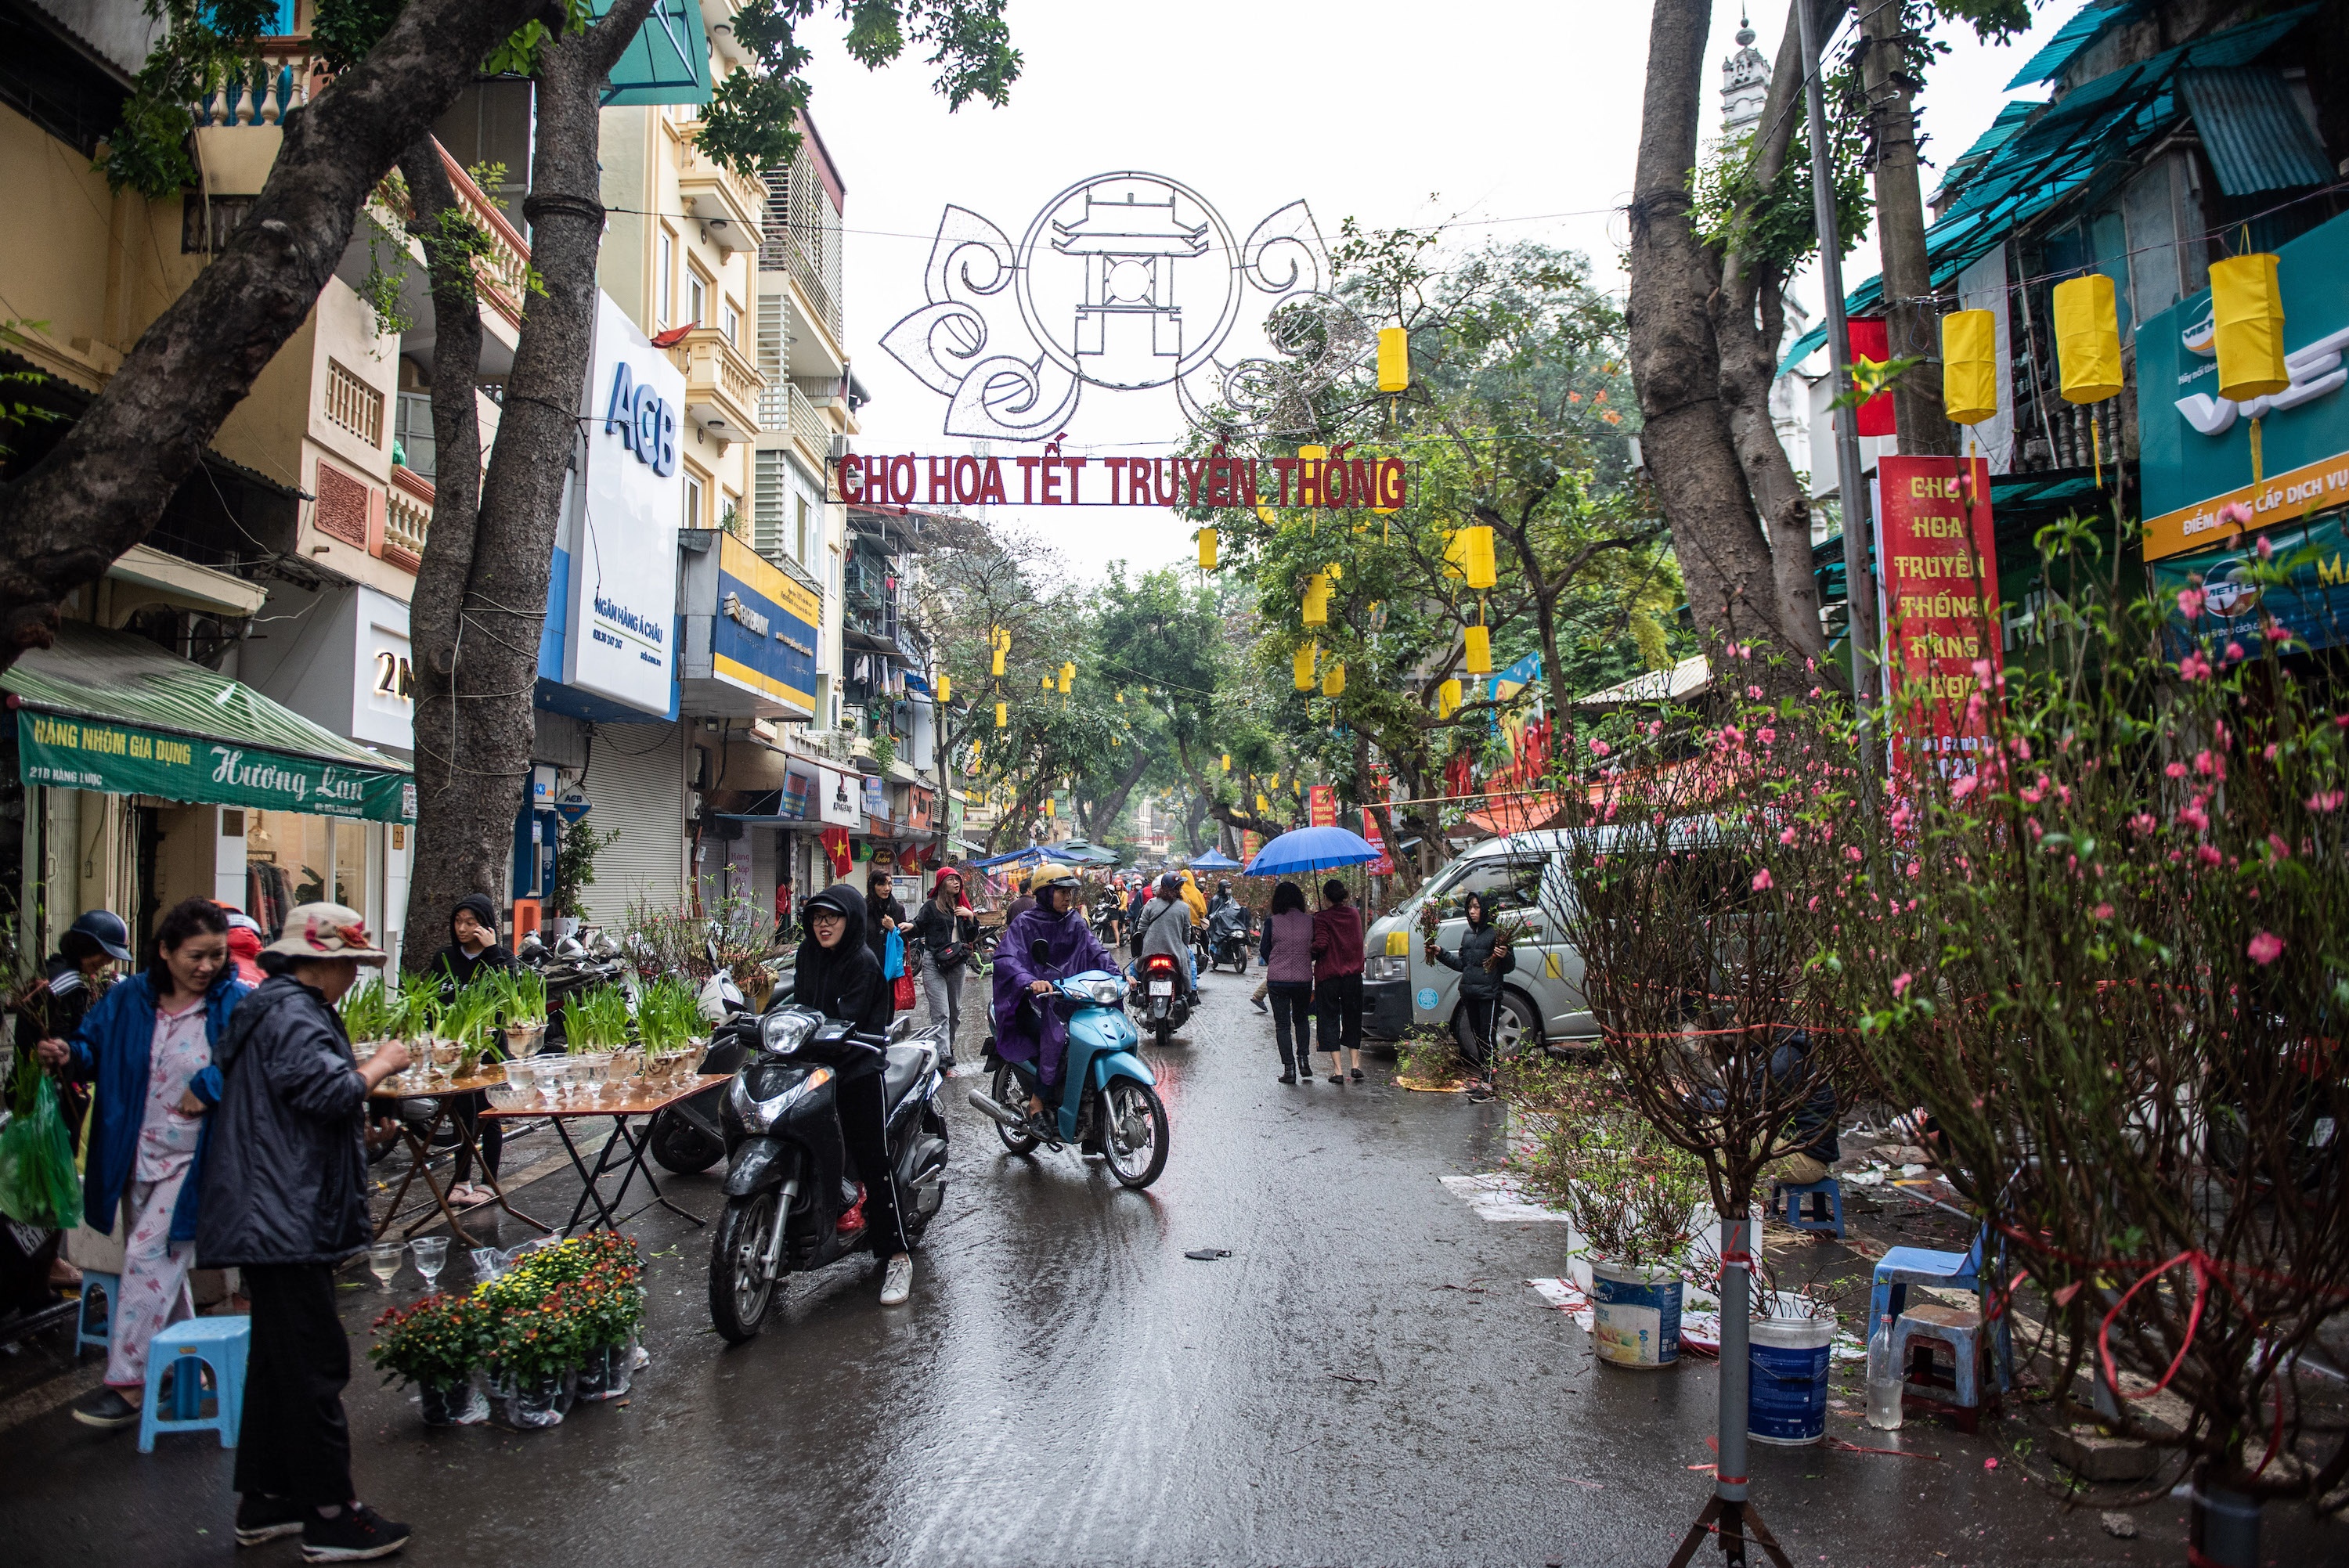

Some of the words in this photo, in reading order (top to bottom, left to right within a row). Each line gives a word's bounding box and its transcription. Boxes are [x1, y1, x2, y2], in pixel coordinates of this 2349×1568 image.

[605, 361, 677, 478] ACB
[838, 452, 917, 515] CHỢ
[929, 455, 1006, 505] HOA
[1017, 432, 1087, 505] TẾT
[1104, 434, 1256, 507] TRUYỀN
[1272, 441, 1407, 509] THỐNG
[2183, 509, 2214, 536] ĐIỂM
[2256, 487, 2283, 513] CẤP
[2287, 478, 2323, 505] DỊCH
[2326, 468, 2349, 492] VỤ
[1911, 516, 1964, 538] HOA
[1894, 548, 1986, 580] TRUYỀN
[594, 598, 617, 622] NGÂN
[618, 606, 638, 632] HÀNG
[639, 615, 644, 635] Á
[644, 622, 662, 643] CHÂU
[34, 717, 78, 748] HÀNG
[81, 726, 127, 755] NHÔM
[129, 735, 153, 759] GIA
[156, 740, 192, 766] DỤNG
[29, 766, 49, 779] 21B
[52, 768, 77, 783] HÀNG
[79, 772, 103, 787] LƯỢC
[210, 745, 309, 802] Hương
[1928, 758, 1978, 780] 020
[395, 831, 404, 843] 23
